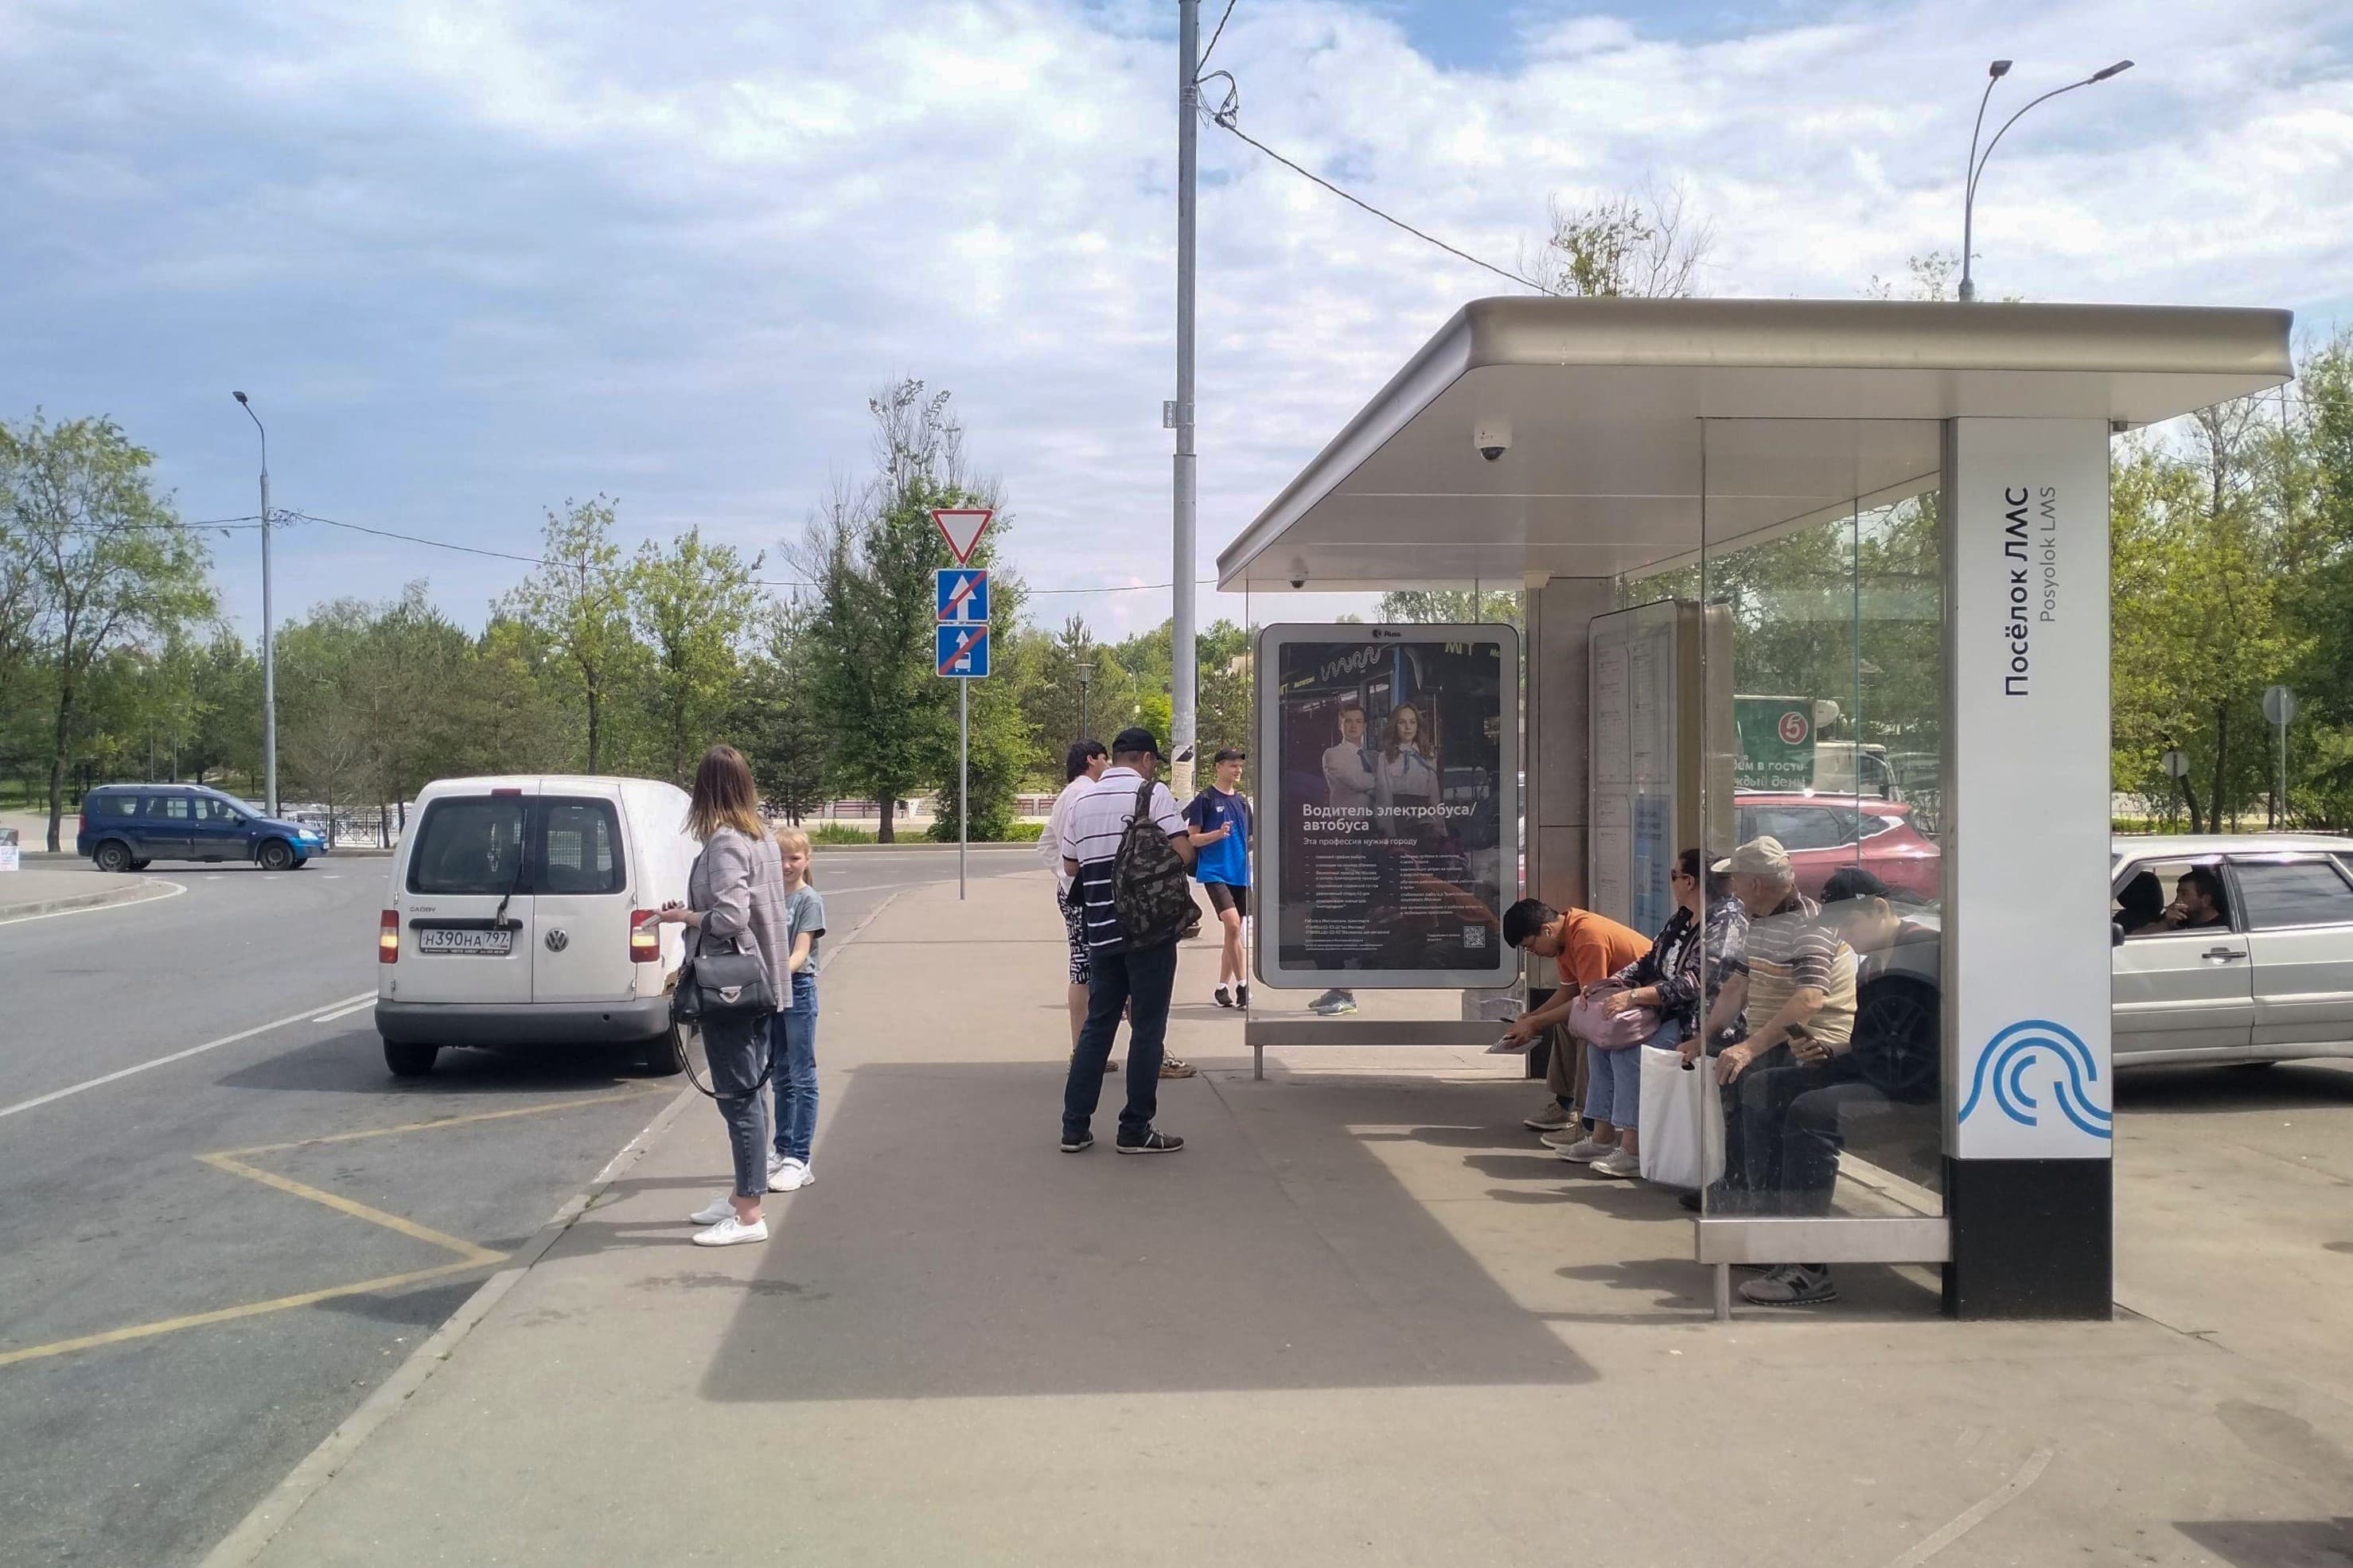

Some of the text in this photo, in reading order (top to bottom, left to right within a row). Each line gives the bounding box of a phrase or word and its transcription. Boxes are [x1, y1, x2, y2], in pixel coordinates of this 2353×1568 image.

[2039, 486, 2059, 622] Posyolok LMS
[2004, 487, 2029, 696] Посёлок ЛМС
[1302, 802, 1478, 818] Водитель электробуса/
[1303, 819, 1369, 833] автобуса
[1319, 838, 1362, 846] профессия
[485, 932, 508, 944] 797
